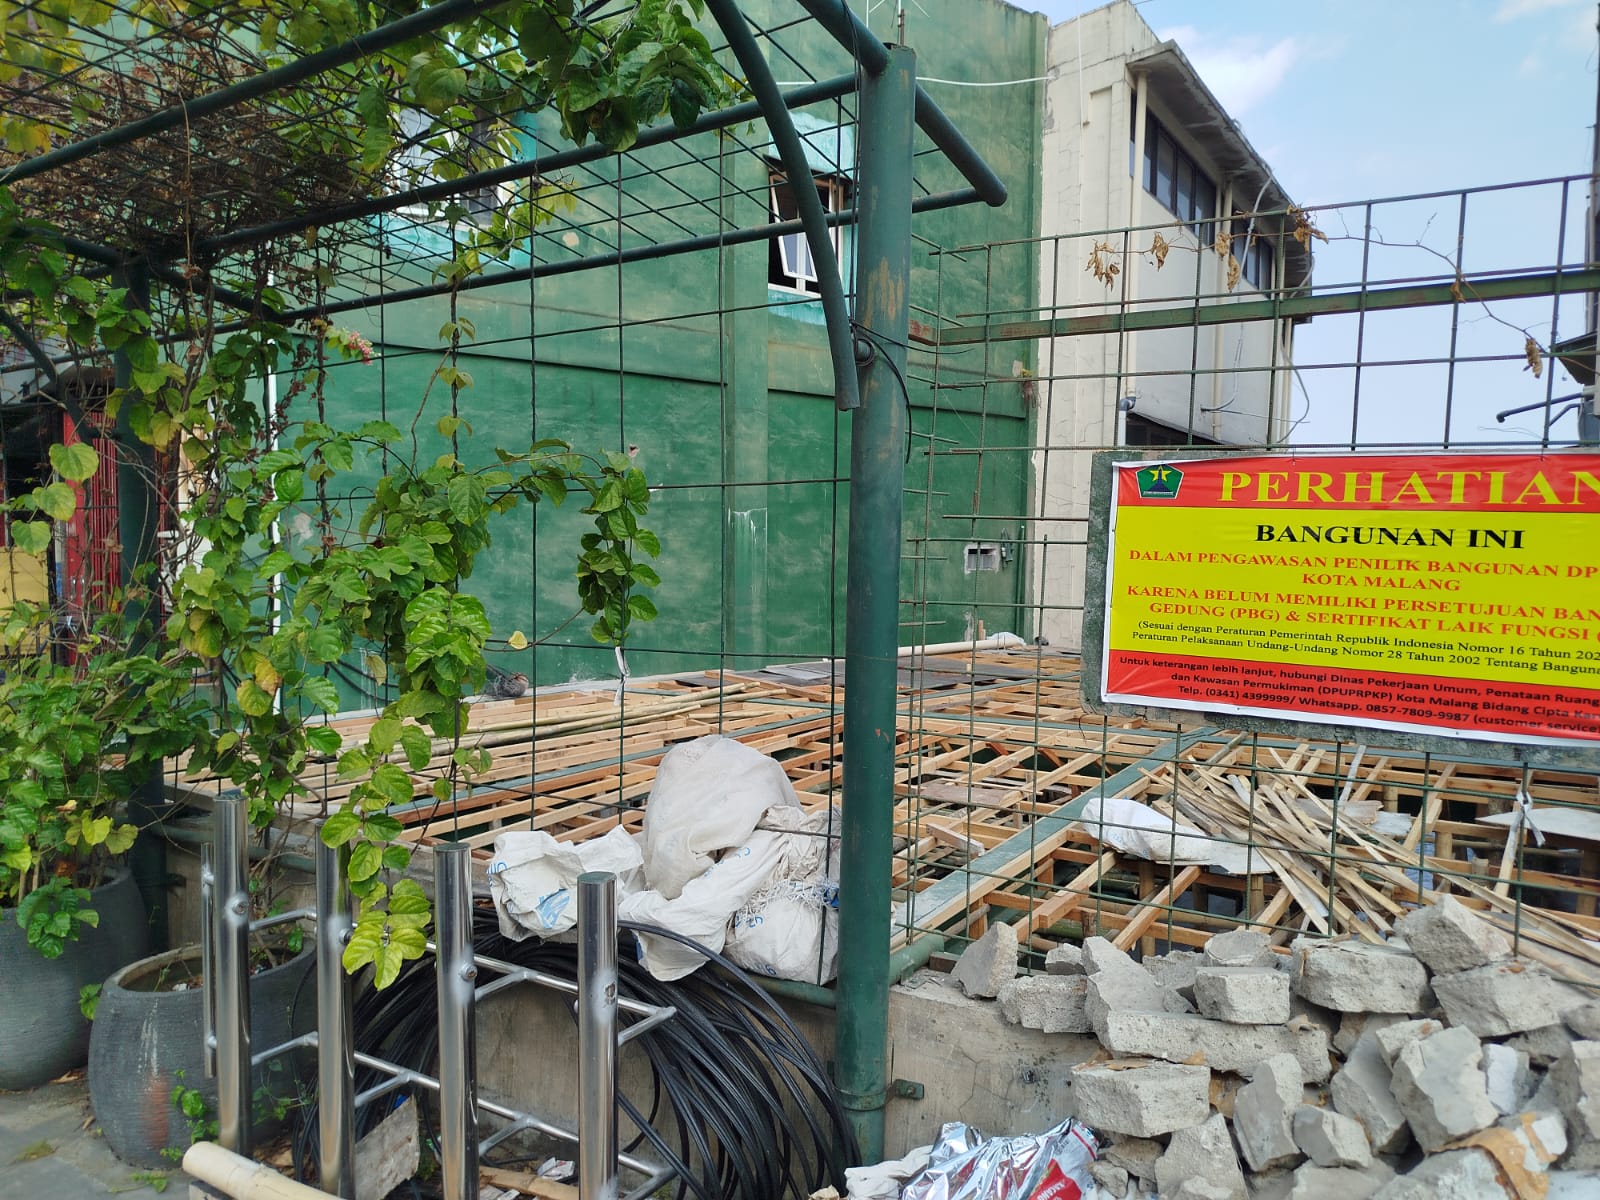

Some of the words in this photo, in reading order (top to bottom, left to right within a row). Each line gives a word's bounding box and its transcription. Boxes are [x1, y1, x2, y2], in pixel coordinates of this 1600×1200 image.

[1217, 470, 1600, 505] PERHATIAN
[1254, 524, 1457, 547] BANGUNAN
[1466, 529, 1526, 549] INI
[1129, 550, 1193, 563] DALAM
[1197, 553, 1327, 569] PENGAWASAN
[1334, 557, 1421, 571] PENILIK
[1427, 561, 1560, 577] BANGUNAN
[1302, 573, 1358, 587] KOTA
[1364, 576, 1461, 592] MALANG
[1127, 585, 1199, 600] KARENA
[1204, 589, 1270, 603] BELUM
[1276, 592, 1377, 609] MEMILIKI
[1383, 598, 1548, 620] PERSETUJUAN
[1149, 602, 1225, 618] GEDUNG
[1230, 606, 1281, 623] (PBG)
[1286, 611, 1301, 623] &
[1306, 612, 1432, 631] SERTIFIKAT
[1438, 619, 1496, 635] LAIK
[1501, 624, 1590, 642] FUNGSI
[1132, 631, 1178, 642] Peraturan
[1180, 635, 1243, 648] Pelaksanaan
[1247, 640, 1338, 656] Undang-Undang
[1342, 646, 1384, 659] Nomor
[1387, 650, 1403, 660] 28
[1406, 652, 1445, 663] Tahun
[1448, 654, 1481, 666] 2002
[1485, 658, 1538, 671] Tentang
[1138, 620, 1174, 631] (Sesuai
[1176, 623, 1213, 635] dengan
[1216, 626, 1266, 638] Peraturan
[1269, 629, 1333, 642] Pemerintah
[1336, 633, 1390, 647] Republik
[1394, 638, 1454, 651] Indonesia
[1458, 642, 1505, 655] Nomor
[1508, 645, 1525, 656] 16
[1529, 647, 1571, 660] Tahun
[1119, 656, 1150, 667] Untuk
[1152, 659, 1209, 672] keterangan
[1212, 663, 1239, 674] lebih
[1241, 666, 1277, 679] lanjut,
[1279, 669, 1327, 683] hubungi
[1330, 673, 1364, 685] Dinas
[1367, 677, 1430, 692] Pekerjaan
[1433, 683, 1481, 697] Umum,
[1486, 688, 1550, 702] Penataan
[1171, 672, 1191, 682] dan
[1193, 675, 1240, 687] Kawasan
[1242, 679, 1315, 693] Permukiman
[1317, 684, 1393, 702] (DPUPRPKP)
[1396, 693, 1425, 704] Kota
[1429, 697, 1479, 711] Malang
[1482, 701, 1529, 715] Bidang
[1533, 706, 1569, 717] Cipta
[1178, 685, 1203, 697] Telp.
[1205, 687, 1240, 700] (0341)
[1242, 692, 1296, 705] 4399999/
[1299, 697, 1362, 713] Whatsapp.
[1366, 703, 1470, 723] 0857-7809-9987
[1473, 714, 1543, 728] (customer
